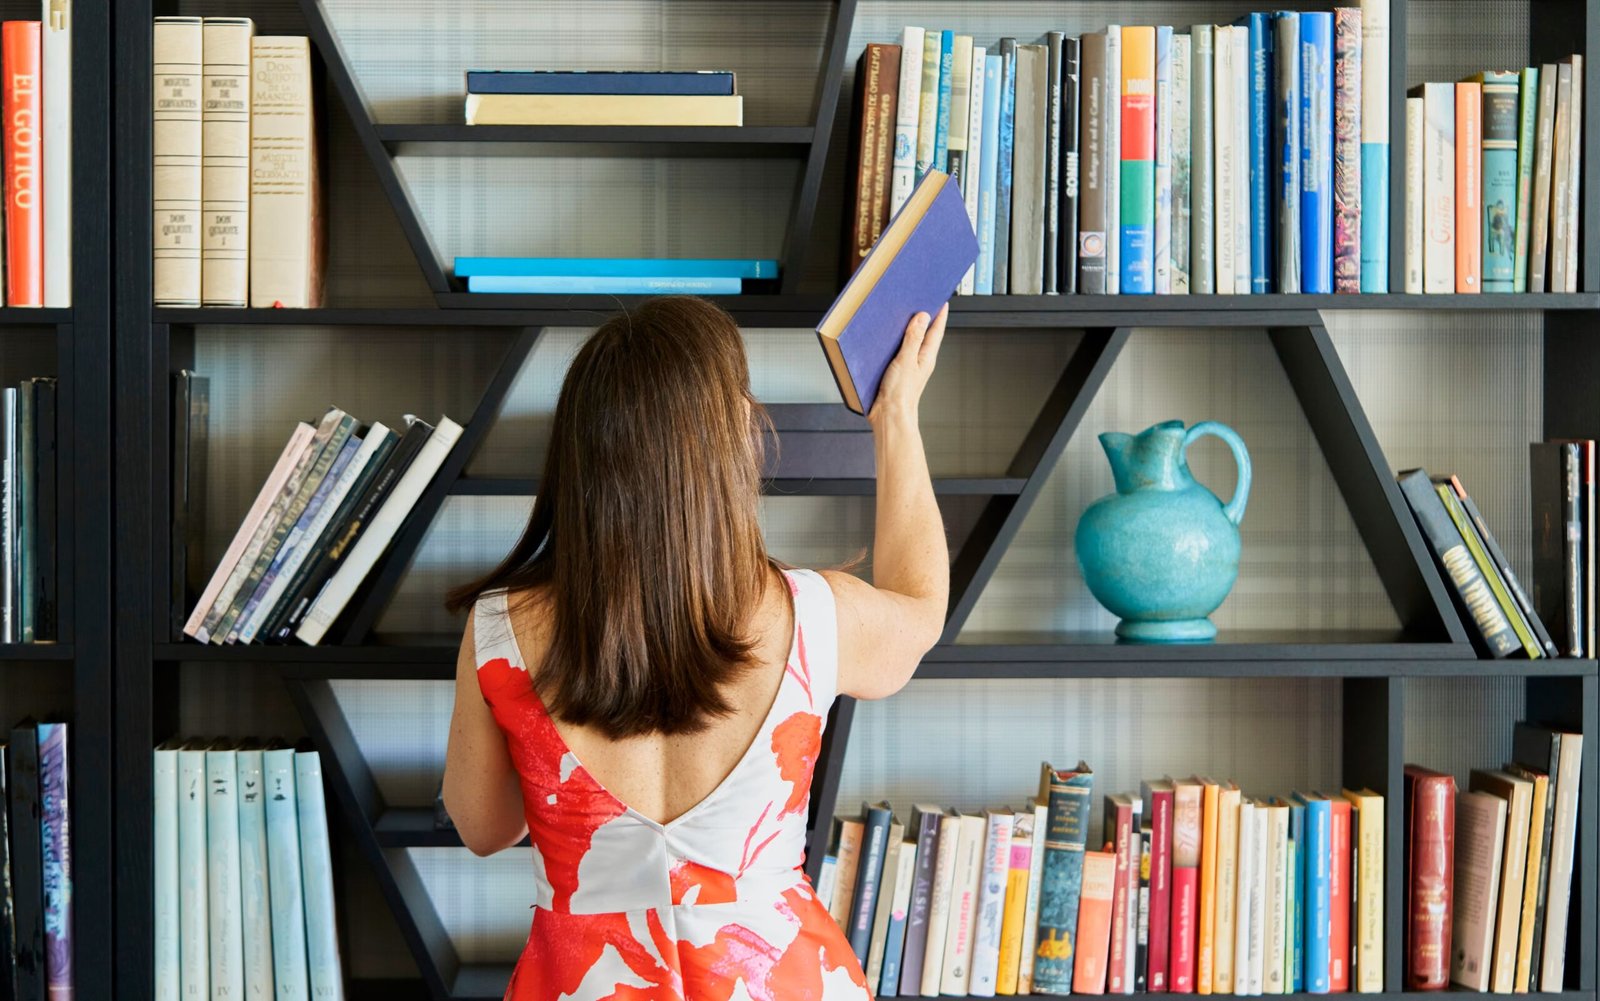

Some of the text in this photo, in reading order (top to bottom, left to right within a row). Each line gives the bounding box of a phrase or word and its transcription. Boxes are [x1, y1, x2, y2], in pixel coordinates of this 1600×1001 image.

[1254, 47, 1266, 90] BRAVA
[164, 78, 190, 87] MIGUEL
[211, 79, 238, 88] MIGUEL
[12, 73, 34, 103] EL
[173, 89, 182, 97] DE
[220, 90, 230, 98] DE
[158, 99, 196, 107] CERVANTES
[206, 100, 244, 108] CERVANTES
[902, 175, 907, 186] 1
[216, 216, 231, 224] DON
[1428, 194, 1454, 244] Geisha
[163, 225, 192, 235] QUIJOTE
[209, 226, 238, 237] QUIJOTE
[275, 485, 310, 536] FIGURA
[259, 536, 280, 563] DEL
